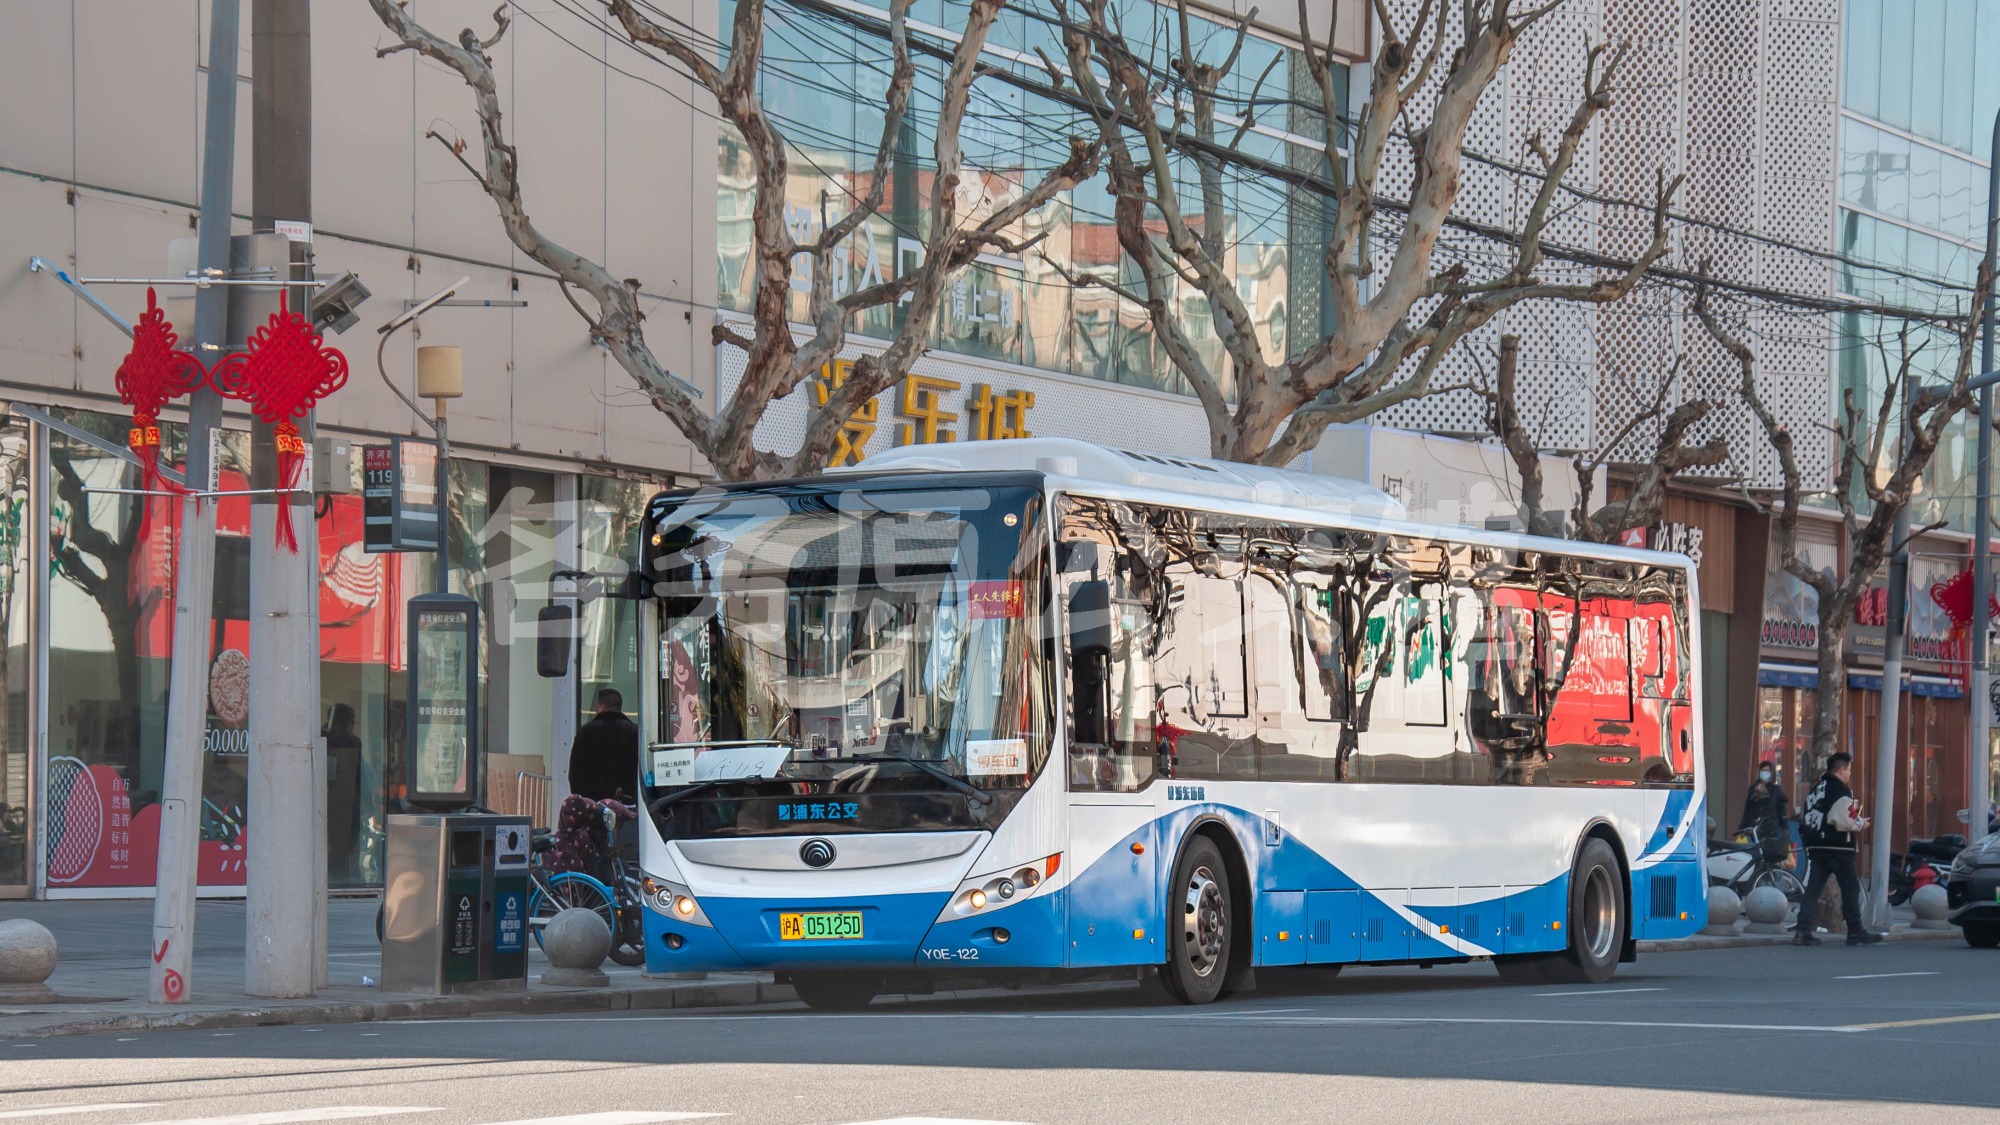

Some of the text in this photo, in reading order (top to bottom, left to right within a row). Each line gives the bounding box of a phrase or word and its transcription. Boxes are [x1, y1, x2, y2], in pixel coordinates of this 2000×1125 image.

[368, 470, 392, 483] 119
[1655, 519, 1703, 569] 必胜客
[972, 587, 1020, 604] 工人先锋号
[978, 753, 1019, 769] 停车证
[793, 802, 859, 820] 浦东公交
